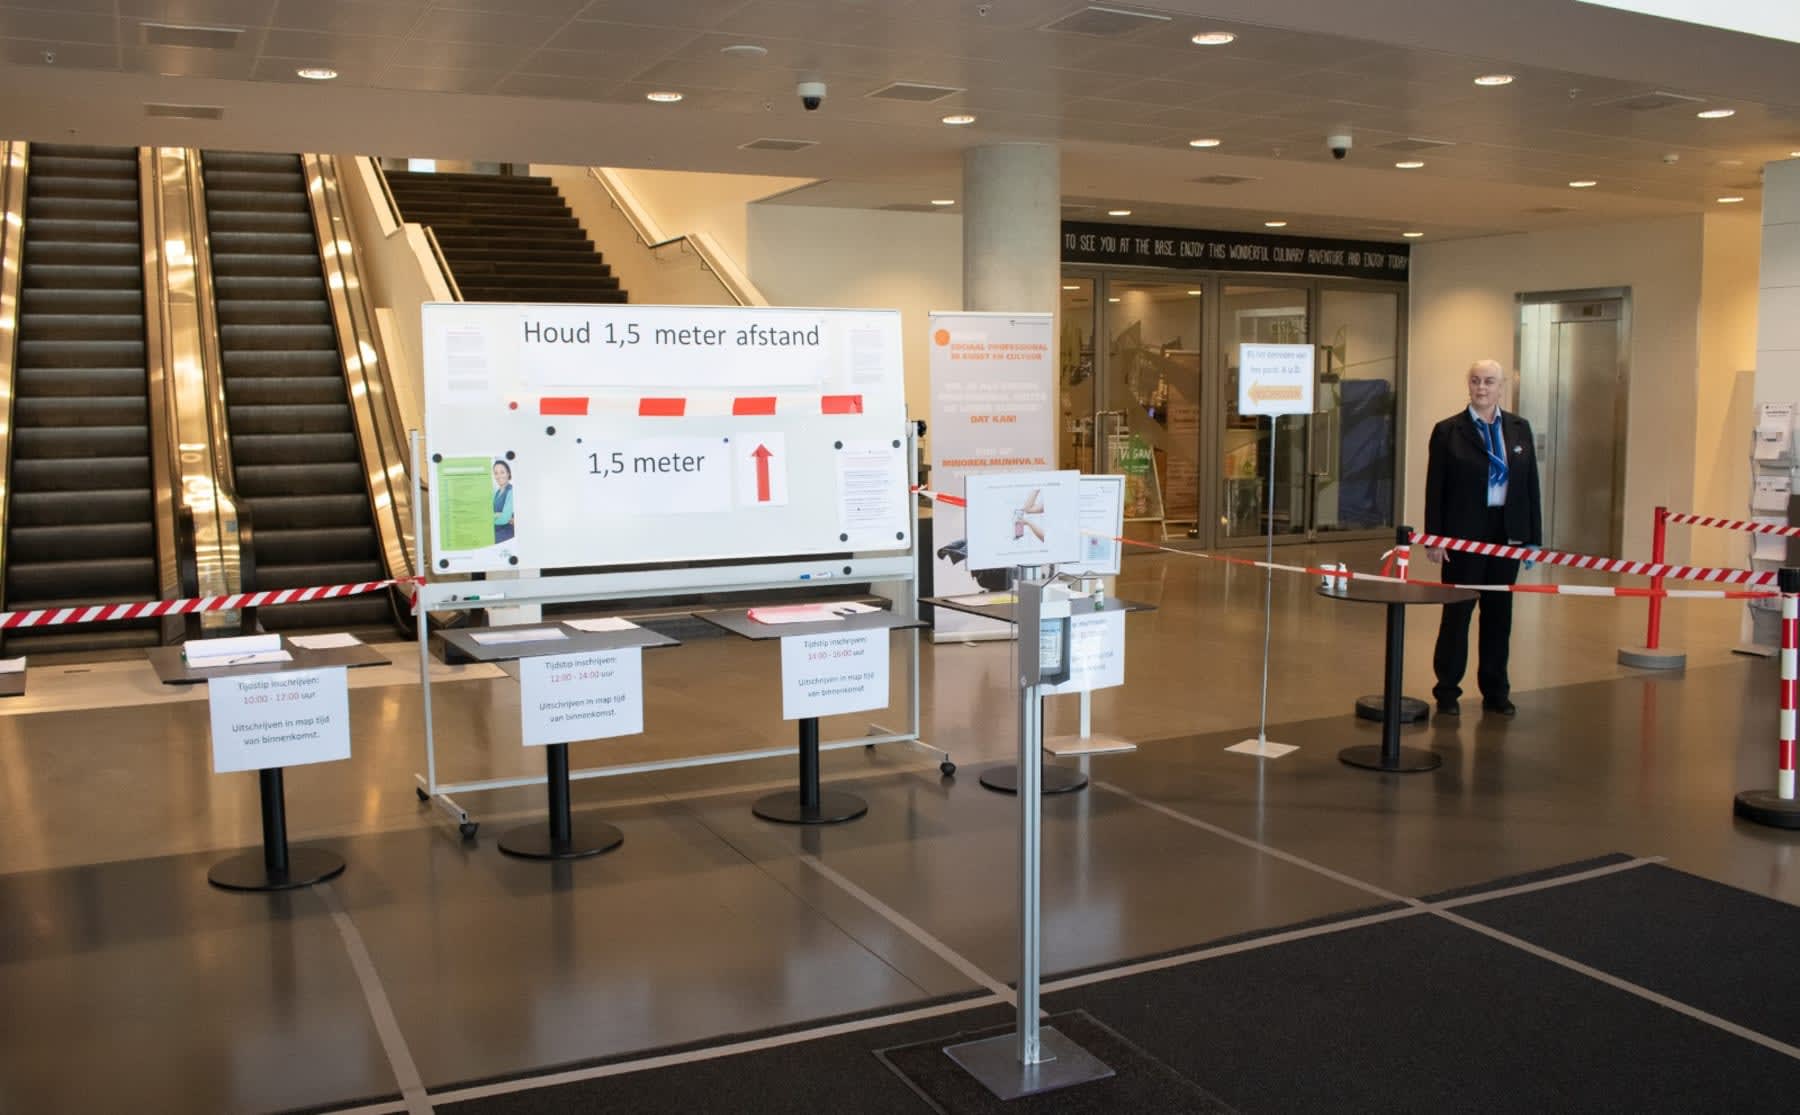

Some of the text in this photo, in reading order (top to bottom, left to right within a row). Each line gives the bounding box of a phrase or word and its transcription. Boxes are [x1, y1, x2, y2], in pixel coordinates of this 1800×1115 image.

[1064, 233, 1076, 250] TO
[1081, 234, 1096, 251] SEE
[1100, 236, 1116, 252] YOU
[1120, 237, 1130, 253] AT
[1136, 238, 1150, 254] THE
[1180, 240, 1204, 257] ENJOY
[1208, 242, 1225, 259] THIS
[1230, 244, 1269, 261] WONDERFUL
[1273, 248, 1304, 262] CULINARY
[1308, 249, 1344, 265] ADVENTURE
[1348, 251, 1361, 266] AND
[1364, 252, 1384, 268] ENJOY
[524, 321, 820, 347] Houd 1,5 meter afstand
[970, 415, 990, 424] DAT
[588, 452, 705, 478] 1,5 meter
[545, 661, 574, 671] Tijdstip
[238, 681, 269, 692] Tijdstip
[244, 695, 268, 704] 10:00
[301, 692, 316, 700] uur
[540, 700, 584, 711] Uitschrijven
[232, 716, 330, 733] Uitschrijven in map tijd
[244, 737, 260, 745] van
